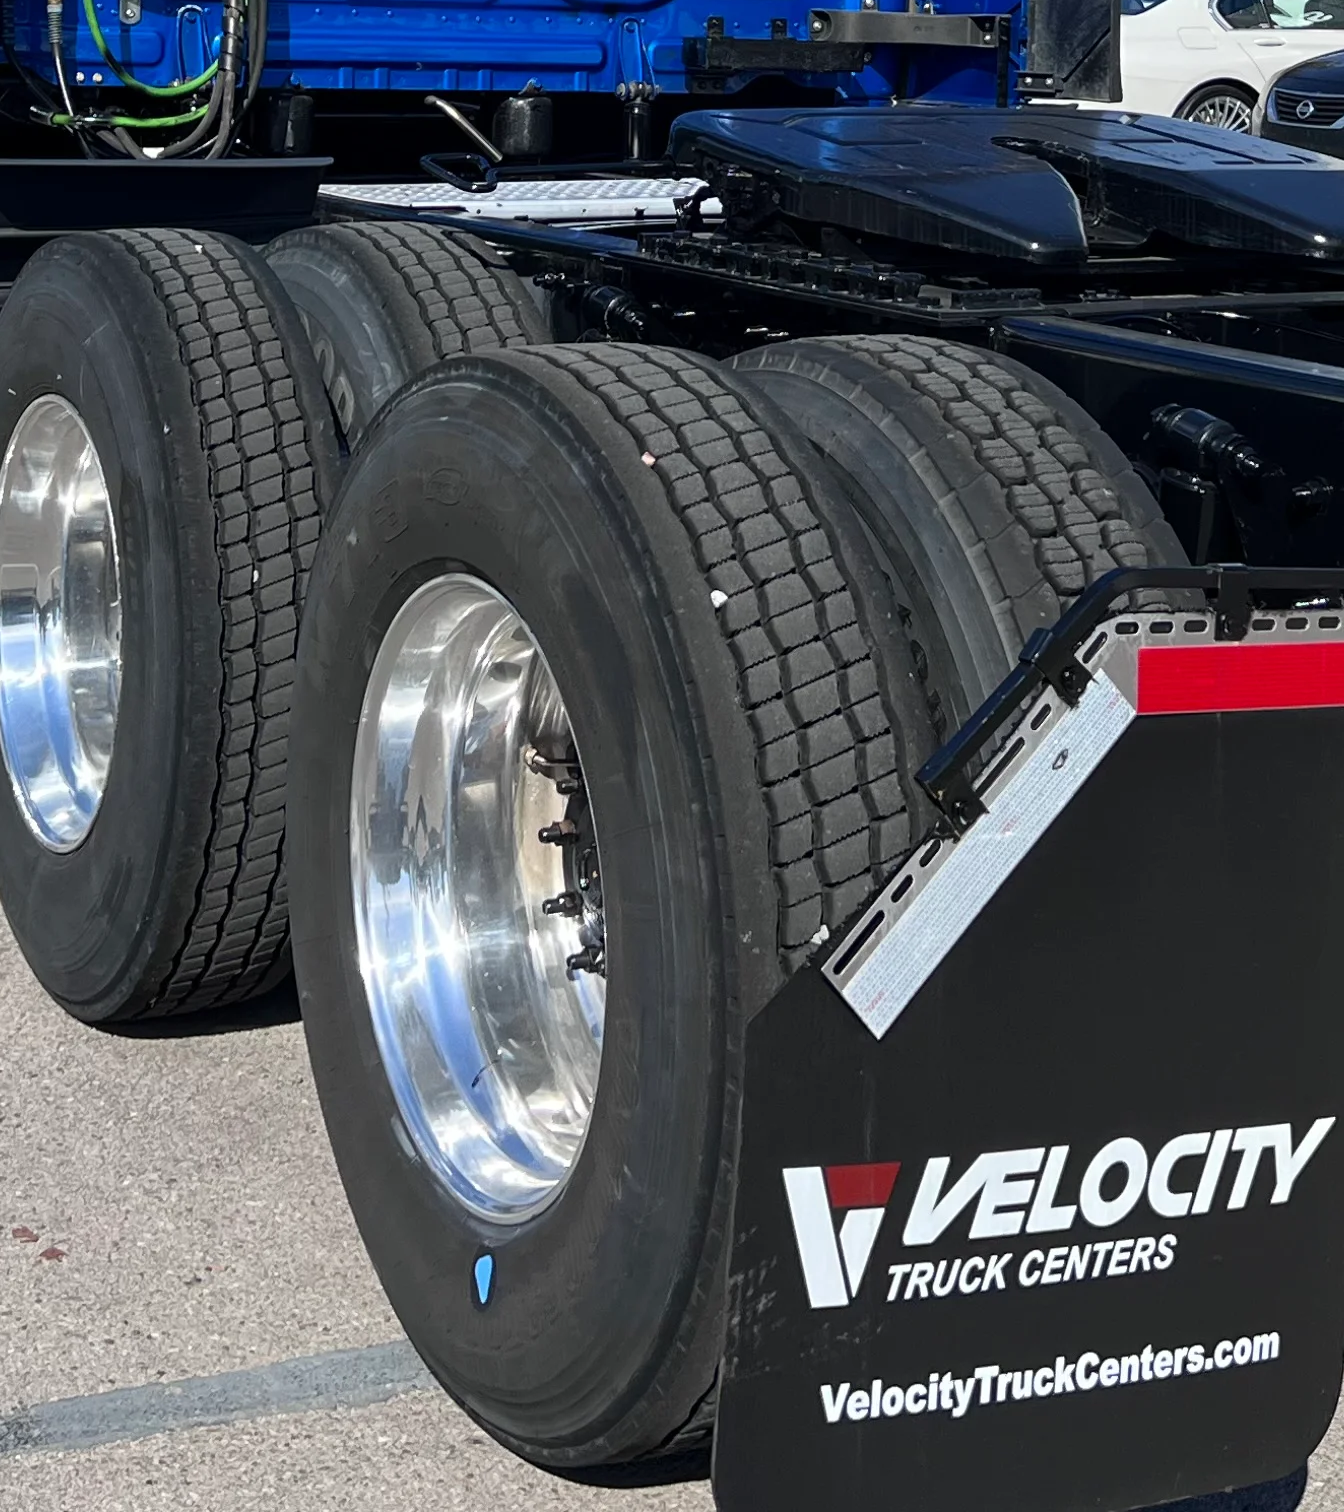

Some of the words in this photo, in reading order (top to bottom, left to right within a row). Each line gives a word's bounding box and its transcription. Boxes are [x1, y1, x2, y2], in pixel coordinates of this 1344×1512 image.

[902, 1116, 1336, 1246] VELOCITY
[886, 1252, 1013, 1302] TRUCK
[1018, 1233, 1178, 1287] CENTERS
[820, 1330, 1280, 1423] VelocityTruckCenters.com
